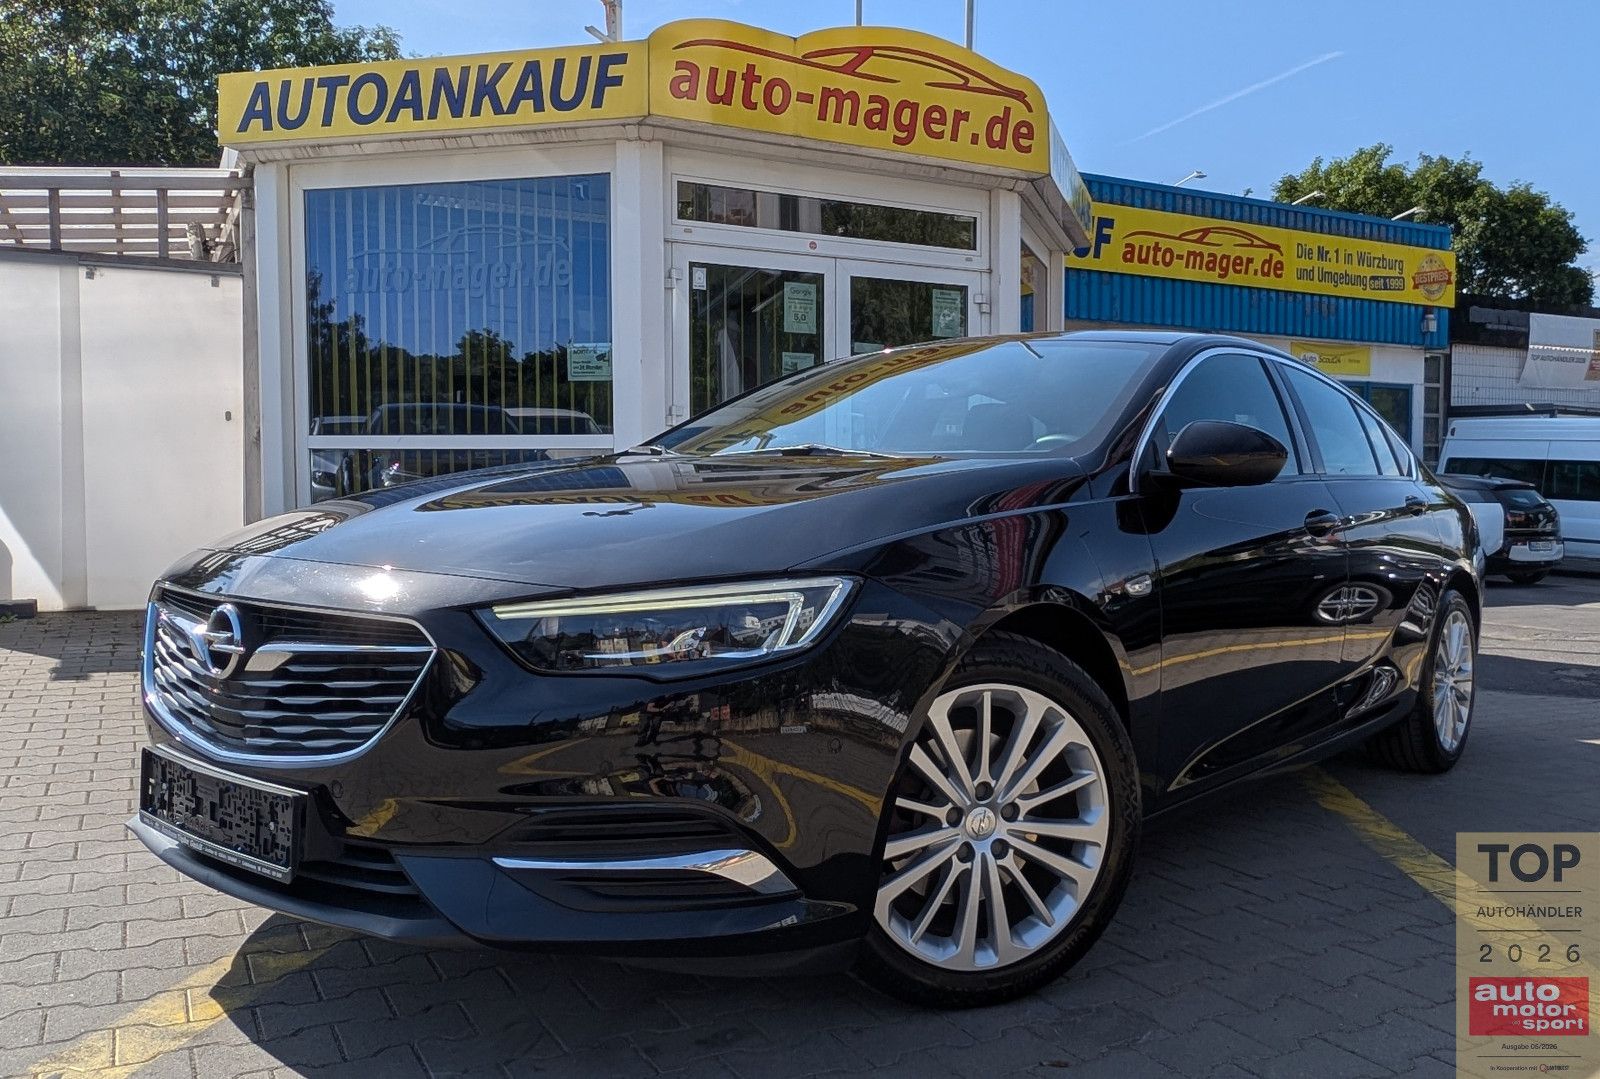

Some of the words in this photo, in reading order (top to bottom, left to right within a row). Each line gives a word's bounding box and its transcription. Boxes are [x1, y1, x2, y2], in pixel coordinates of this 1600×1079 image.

[236, 52, 629, 133] AUTOANKAUF
[669, 60, 1035, 154] auto-mager.de
[1122, 241, 1284, 278] auto-mager.de
[1296, 243, 1313, 260] Die
[1317, 245, 1331, 262] Nr.
[1334, 248, 1340, 263] 1
[1344, 249, 1353, 265] in
[1357, 250, 1404, 275] Würzburg
[1296, 266, 1315, 281] und
[1317, 266, 1368, 291] Umgebung
[1369, 277, 1384, 290] seit
